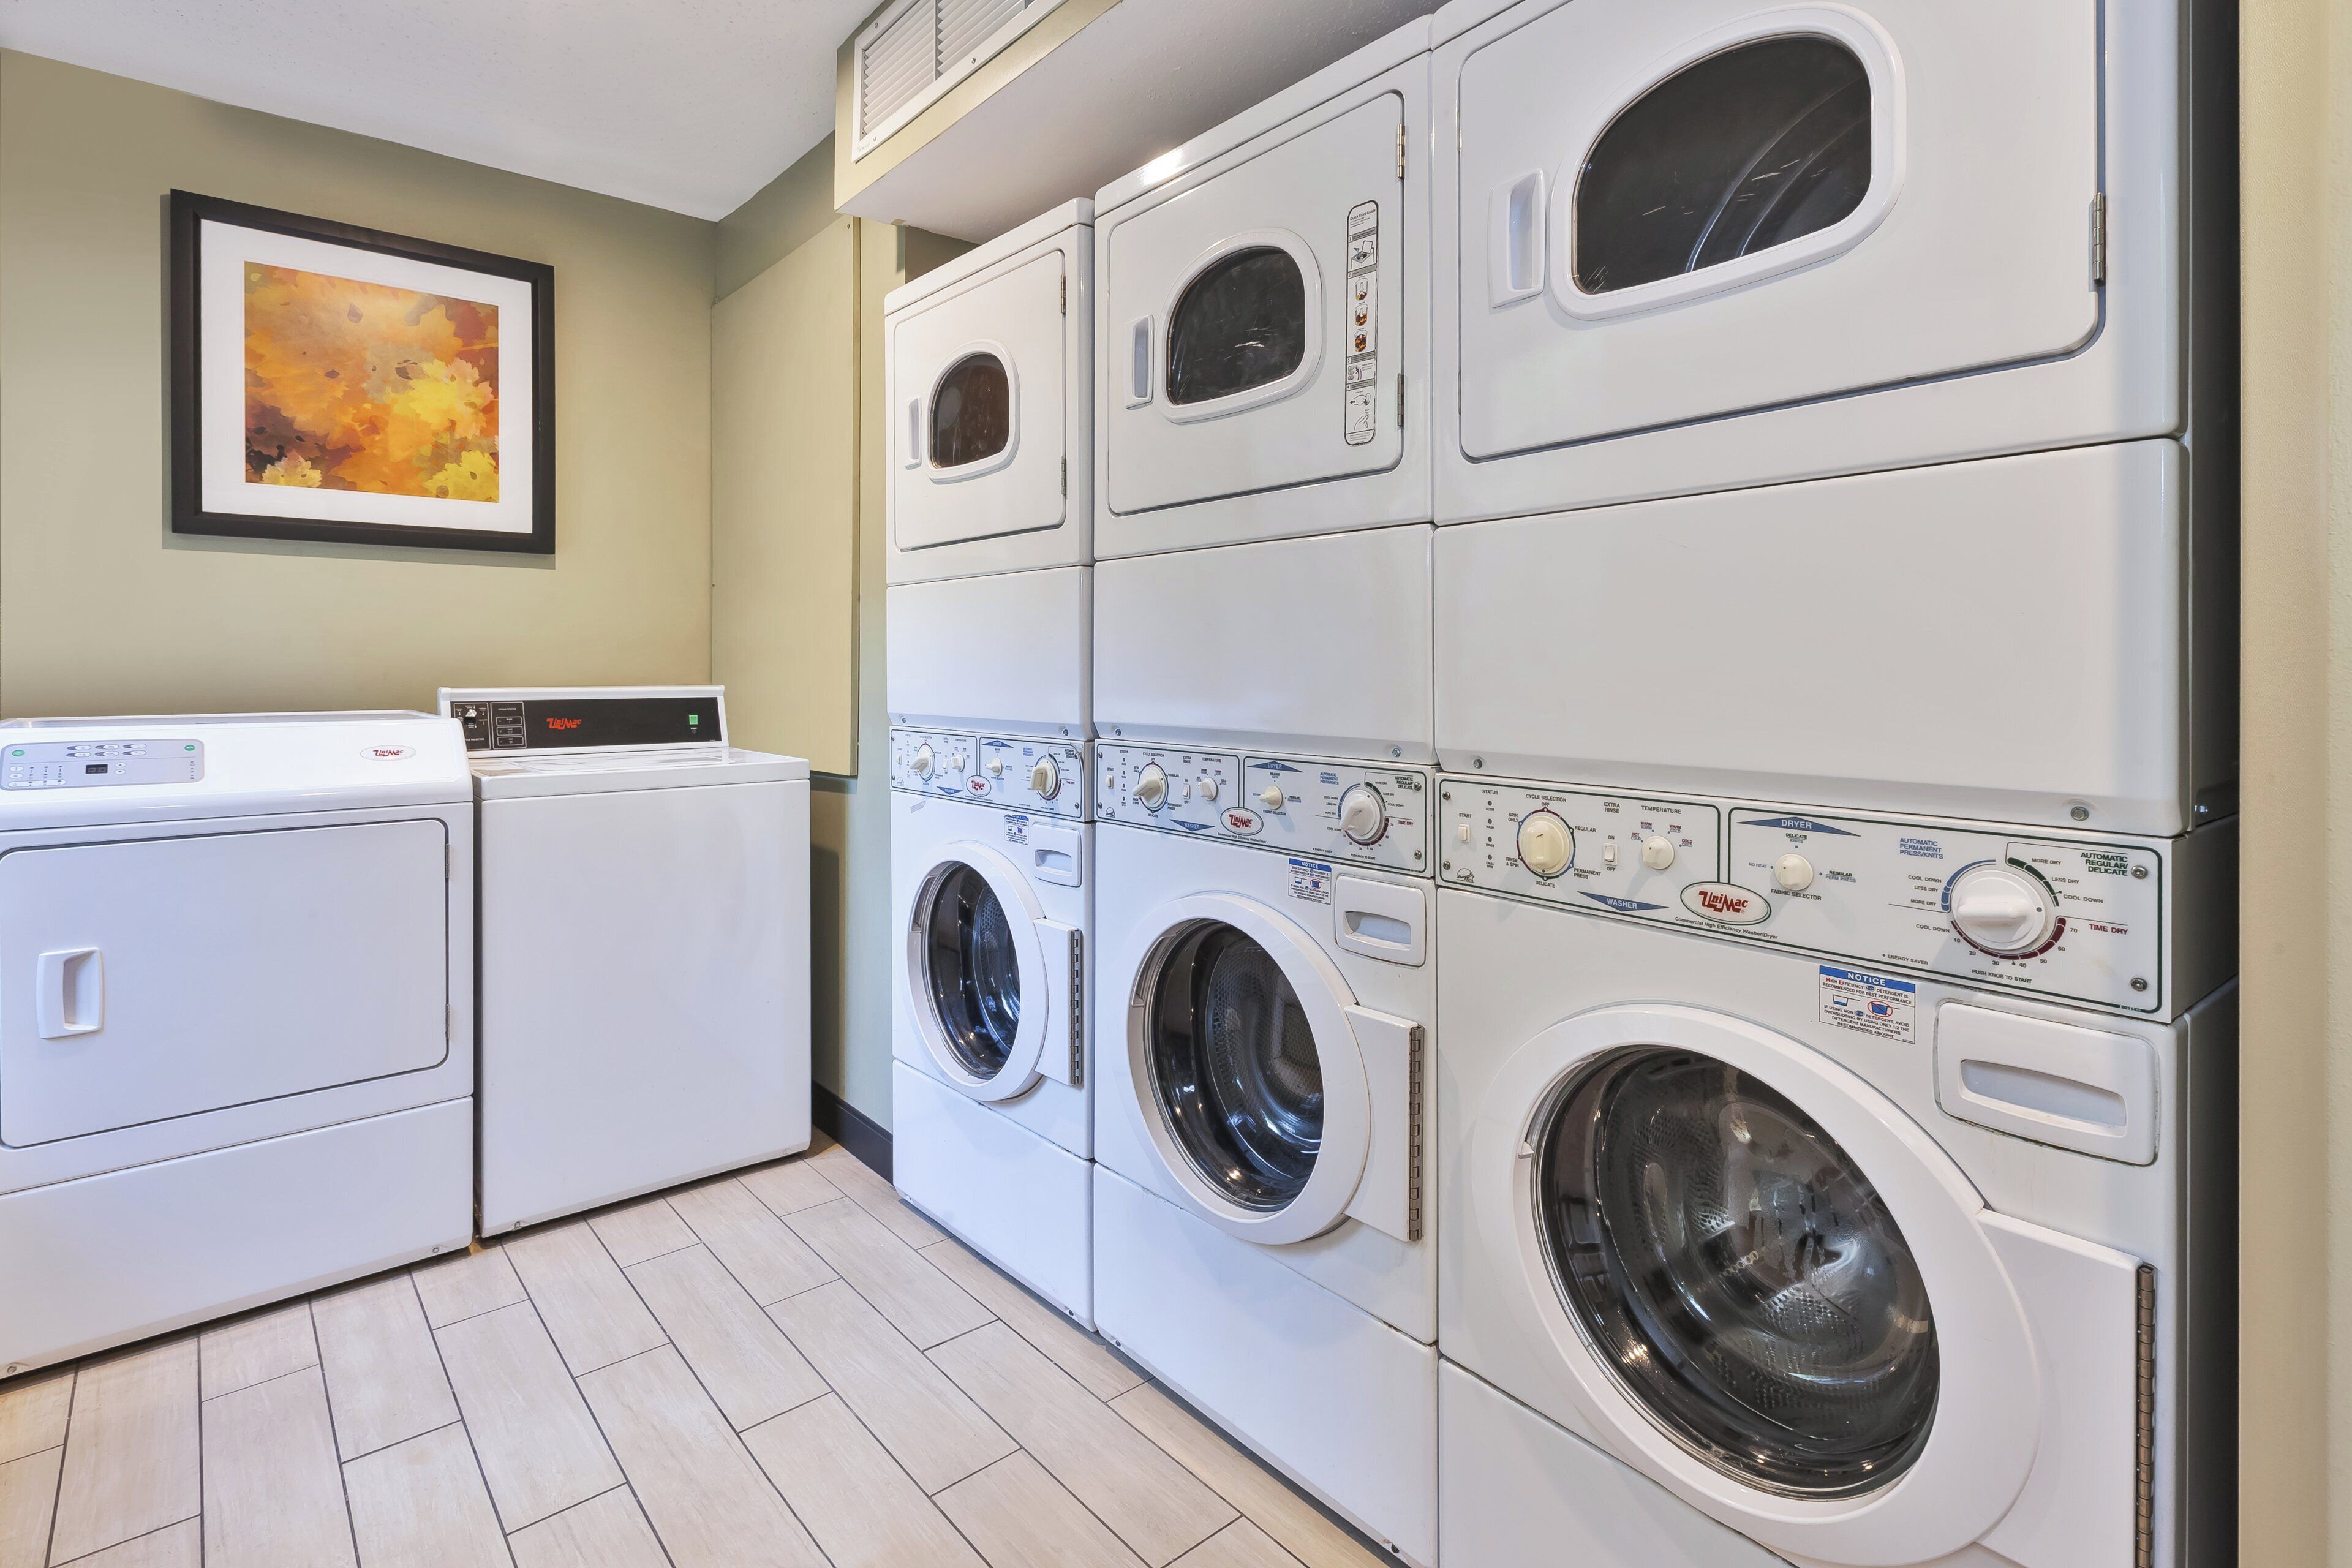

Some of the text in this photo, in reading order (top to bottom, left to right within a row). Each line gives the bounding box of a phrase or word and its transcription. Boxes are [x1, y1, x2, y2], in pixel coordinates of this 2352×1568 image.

[546, 718, 582, 730] UniMac
[1642, 805, 1682, 814] TEMPERATURE
[1229, 814, 1253, 828] UniMac
[1781, 820, 1812, 829] DRYER
[1900, 838, 1938, 846] AUTOMATIC
[1900, 843, 1942, 853] PERMANENT
[1900, 850, 1943, 859] PRESS/KNITS
[2081, 853, 2128, 862] AUTOMATIC
[2085, 859, 2128, 869] REGULAR/
[2088, 866, 2128, 876] DELICATE
[1792, 892, 1822, 900] SELECTOR
[1607, 898, 1637, 909] WASHER
[1698, 891, 1749, 913] UniMac
[1675, 916, 1703, 926] Commercial
[1717, 924, 1743, 933] Efficiency
[1743, 929, 1778, 940] Washer/Dryer
[2089, 924, 2108, 932] TIME
[1847, 973, 1885, 986] NOTICE
[1823, 982, 1855, 992] RECOMMENDED
[1878, 994, 1912, 1005] PERFORMANCE
[1877, 989, 1903, 997] DETERGENT
[1824, 1009, 1855, 1019] OVERSUDSING
[1832, 1016, 1901, 1035] DETERGENT MANUFACTURERS
[1838, 1022, 1872, 1033] RECOMMENDED
